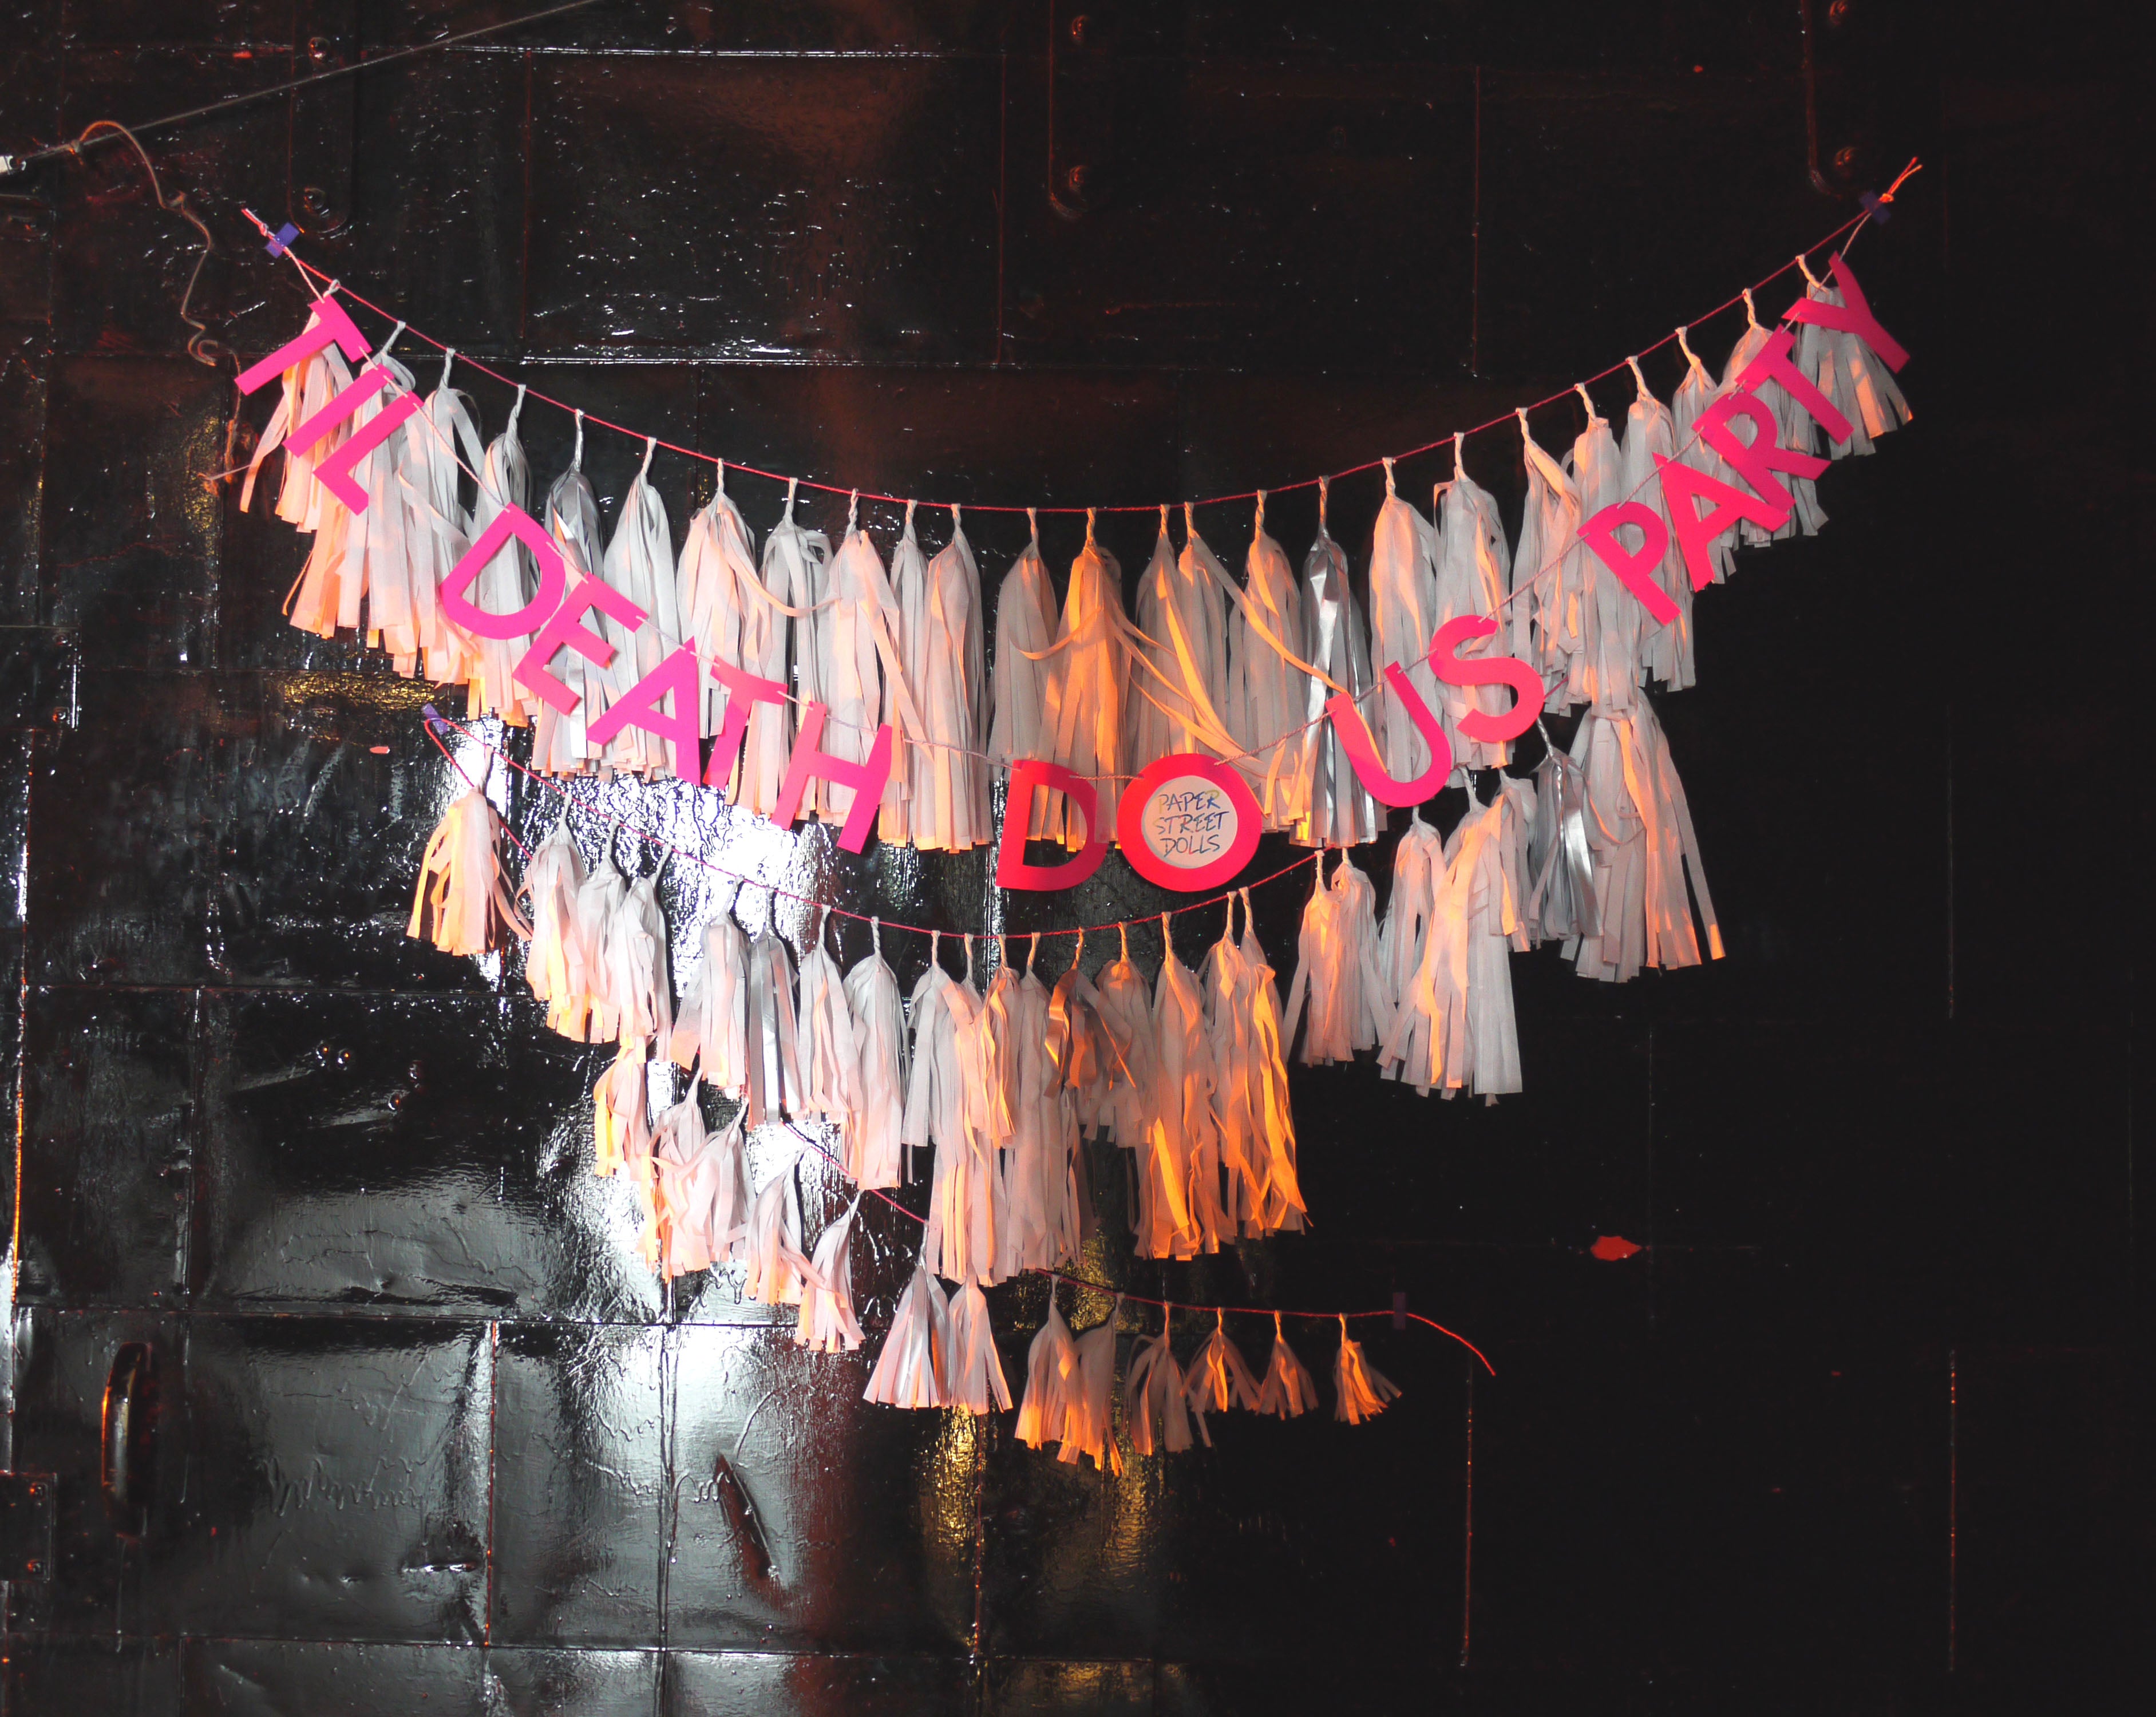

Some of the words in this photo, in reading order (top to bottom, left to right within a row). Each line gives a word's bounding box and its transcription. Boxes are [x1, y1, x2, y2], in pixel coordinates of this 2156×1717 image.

[234, 295, 424, 515] TIL
[438, 502, 893, 854] DEATH
[995, 753, 1263, 892] DO
[1325, 615, 1545, 808] US
[1576, 250, 1910, 626] PARTY
[1158, 789, 1221, 814] PAPER
[1153, 811, 1230, 835] STREET
[1160, 834, 1221, 858] DOLLS
